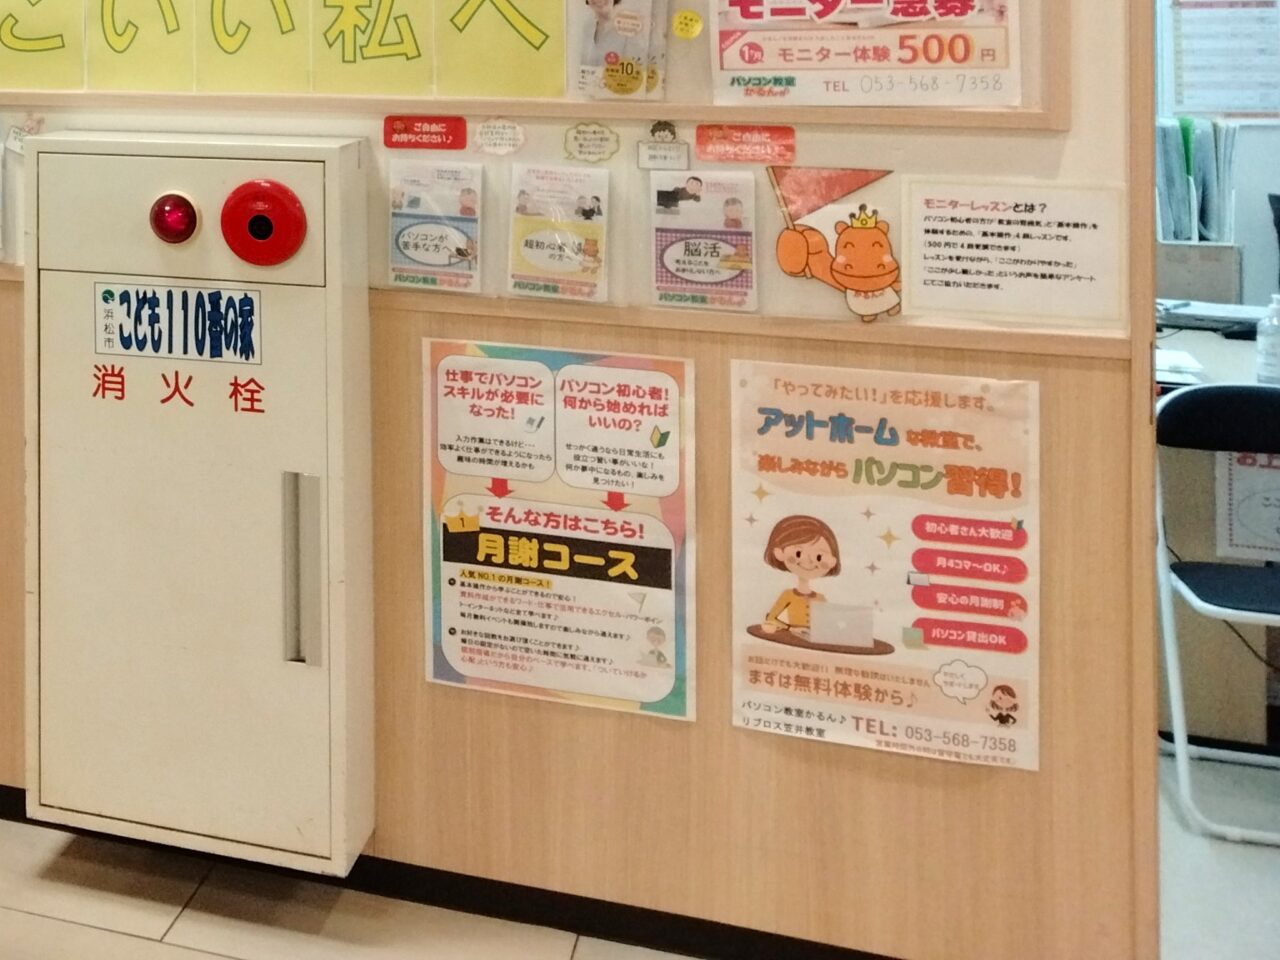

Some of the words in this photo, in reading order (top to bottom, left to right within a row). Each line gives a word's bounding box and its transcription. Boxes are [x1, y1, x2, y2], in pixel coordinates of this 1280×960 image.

[778, 45, 891, 64] モニター体験
[823, 80, 850, 93] TEL
[414, 122, 447, 133] ご自由に
[684, 241, 722, 258] 脳活
[103, 308, 115, 349] 浜松市
[444, 368, 543, 389] 仕事でパソコン
[92, 364, 265, 414] 消火栓
[443, 384, 545, 407] スキルが必要に
[563, 394, 669, 418] 何から始めれば
[924, 521, 1014, 541] 初心者さん大歓迎
[476, 532, 639, 581] 月謝コース
[935, 591, 1005, 611] 安心の月謝制
[931, 627, 1007, 646] パソコン貸出OK
[741, 716, 827, 739] リブロス笠井教室
[905, 725, 1017, 754] 053-568-7358
